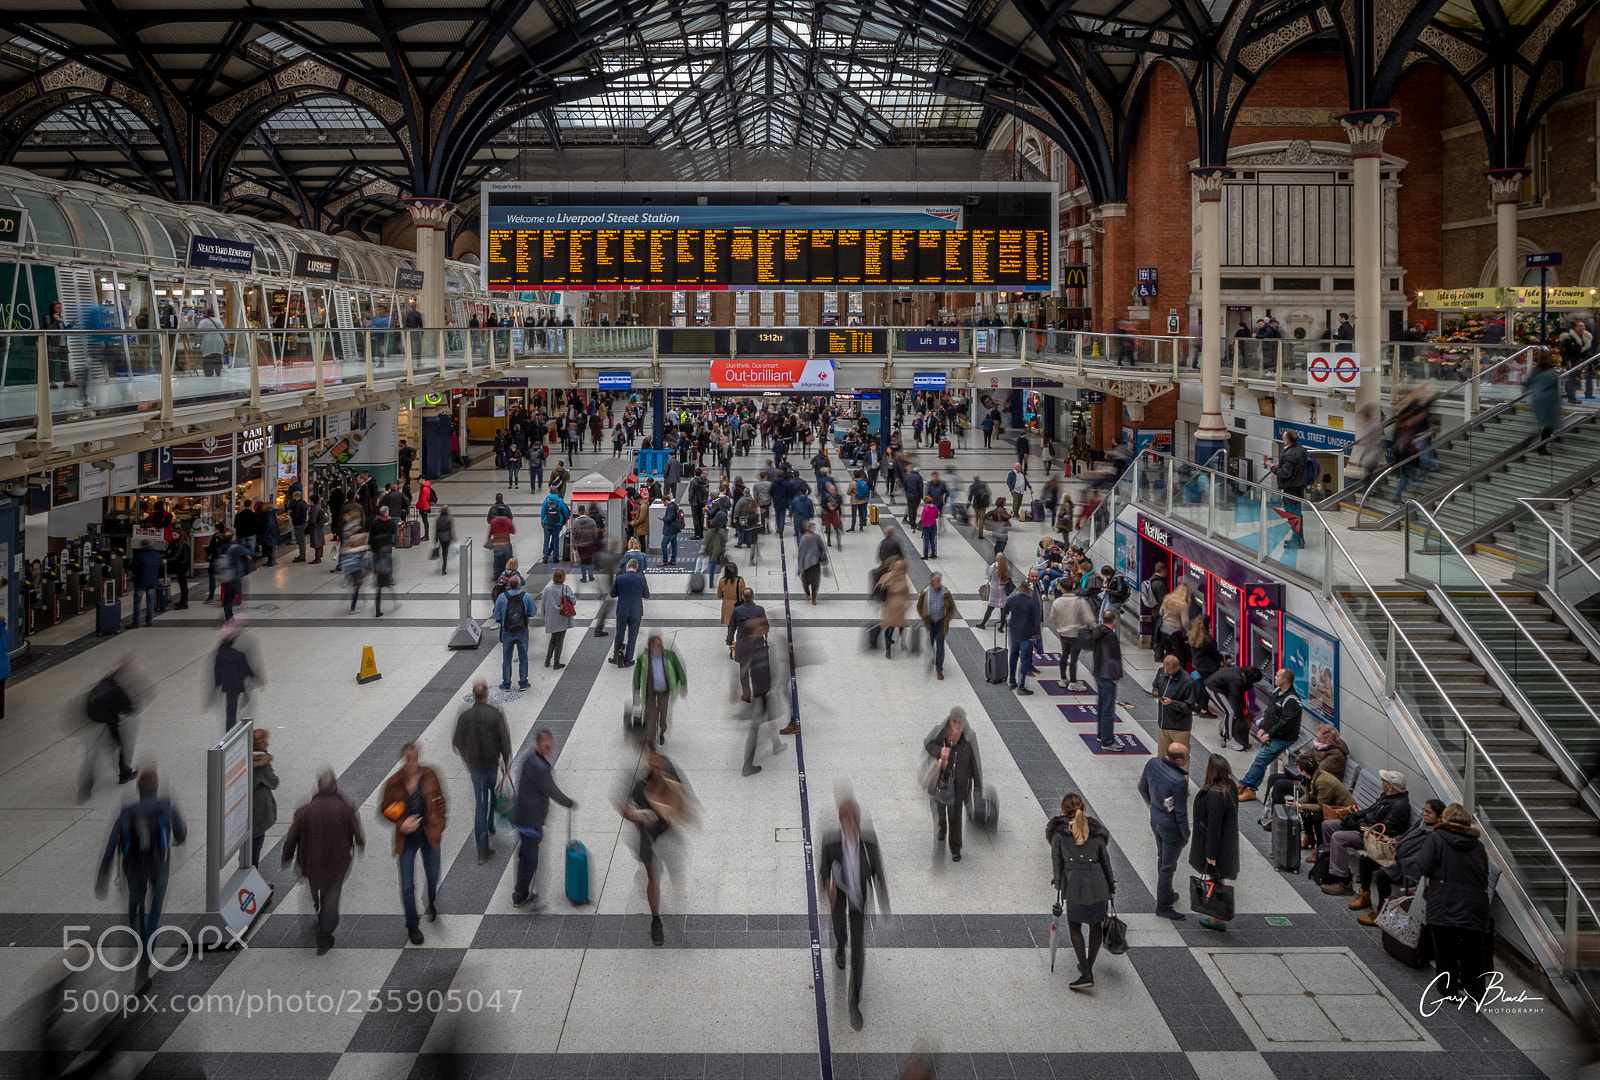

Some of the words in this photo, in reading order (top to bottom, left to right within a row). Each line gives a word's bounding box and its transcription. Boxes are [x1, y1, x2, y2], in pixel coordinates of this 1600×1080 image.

[507, 214, 545, 223] Welcome
[556, 213, 605, 226] Liverpool
[606, 213, 639, 223] Street
[641, 213, 680, 223] Station
[307, 260, 324, 272] LUSH
[1437, 291, 1449, 300] Isle
[1458, 290, 1484, 300] Flowers
[1525, 289, 1540, 297] Isle
[1553, 289, 1585, 298] Flowers
[725, 369, 796, 382] Out-brilliant.
[1307, 432, 1326, 444] STREET
[163, 446, 171, 464] 5
[1144, 521, 1168, 547] NatWest
